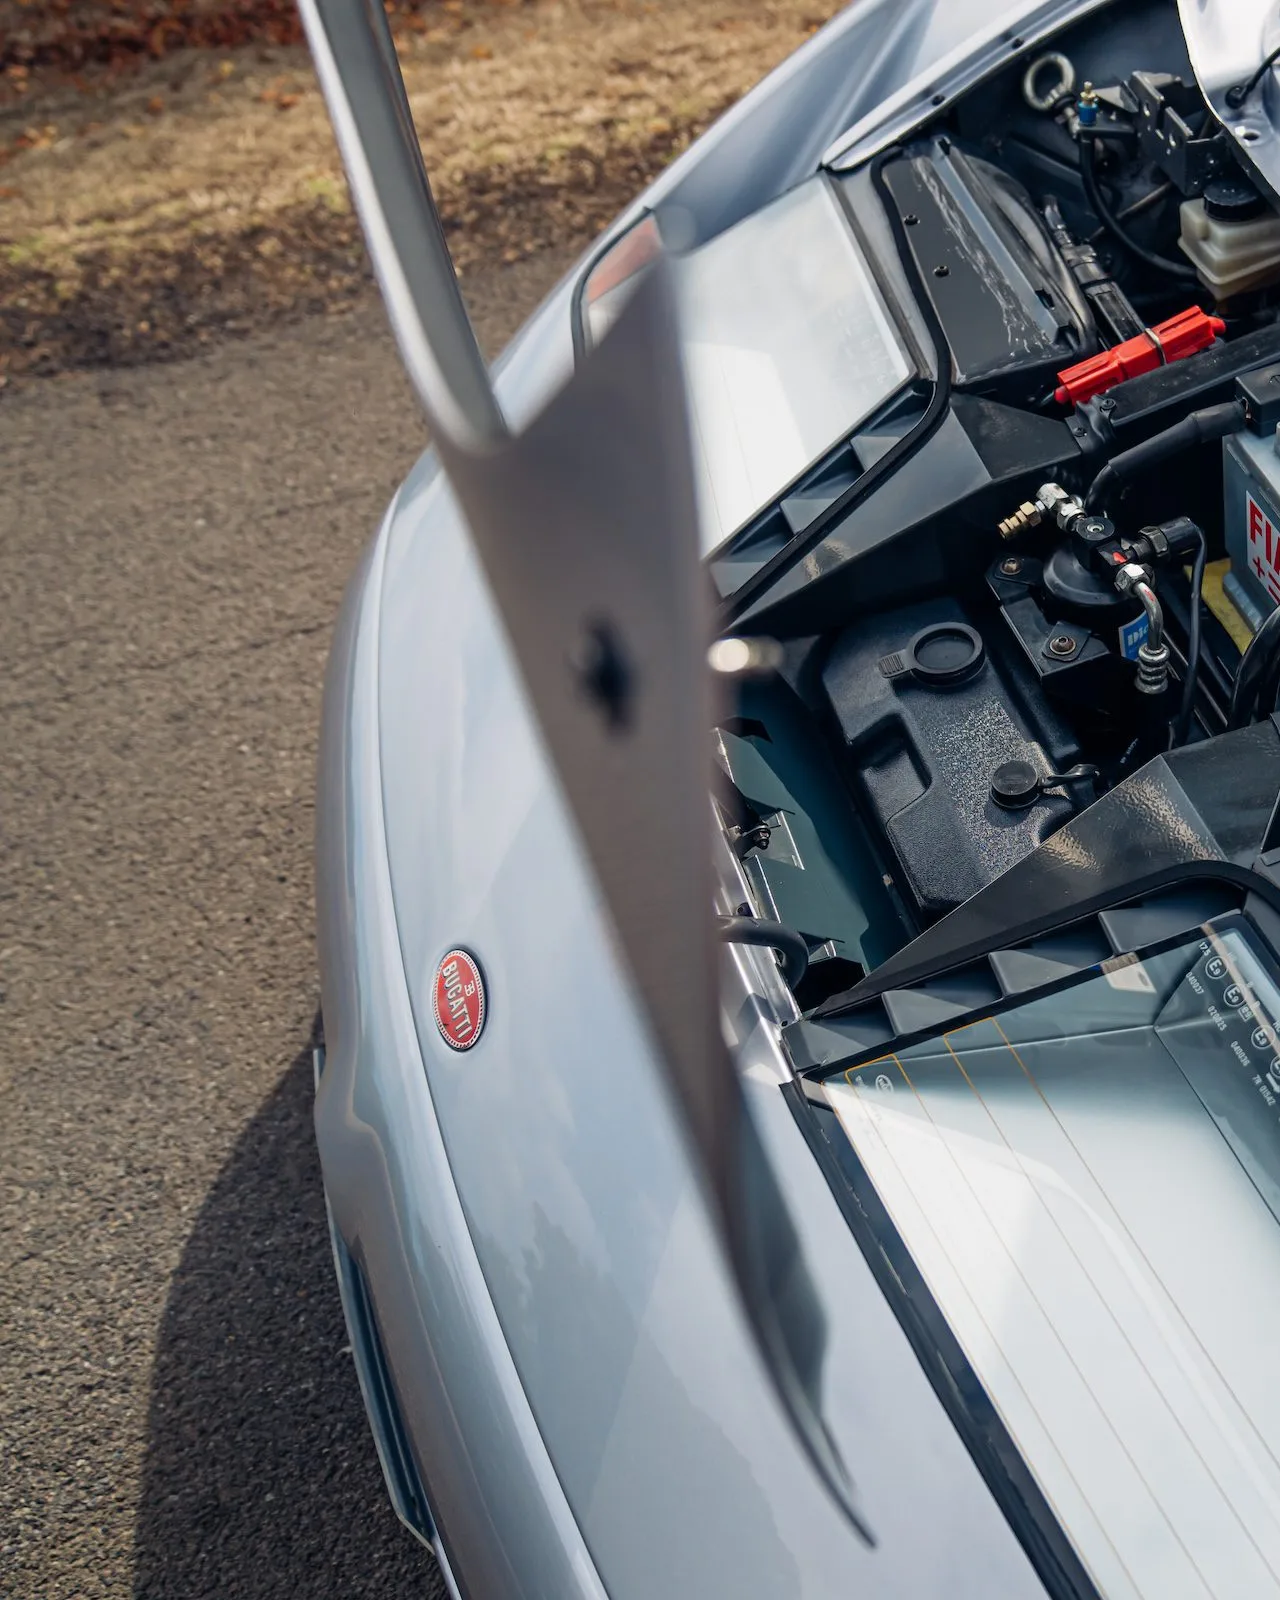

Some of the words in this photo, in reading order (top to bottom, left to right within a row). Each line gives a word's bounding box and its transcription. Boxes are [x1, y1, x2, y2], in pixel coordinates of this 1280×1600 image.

[1199, 942, 1211, 956] 17.5
[1209, 959, 1222, 975] E9
[442, 960, 473, 1039] BUGATTI
[1227, 986, 1240, 1003] E9
